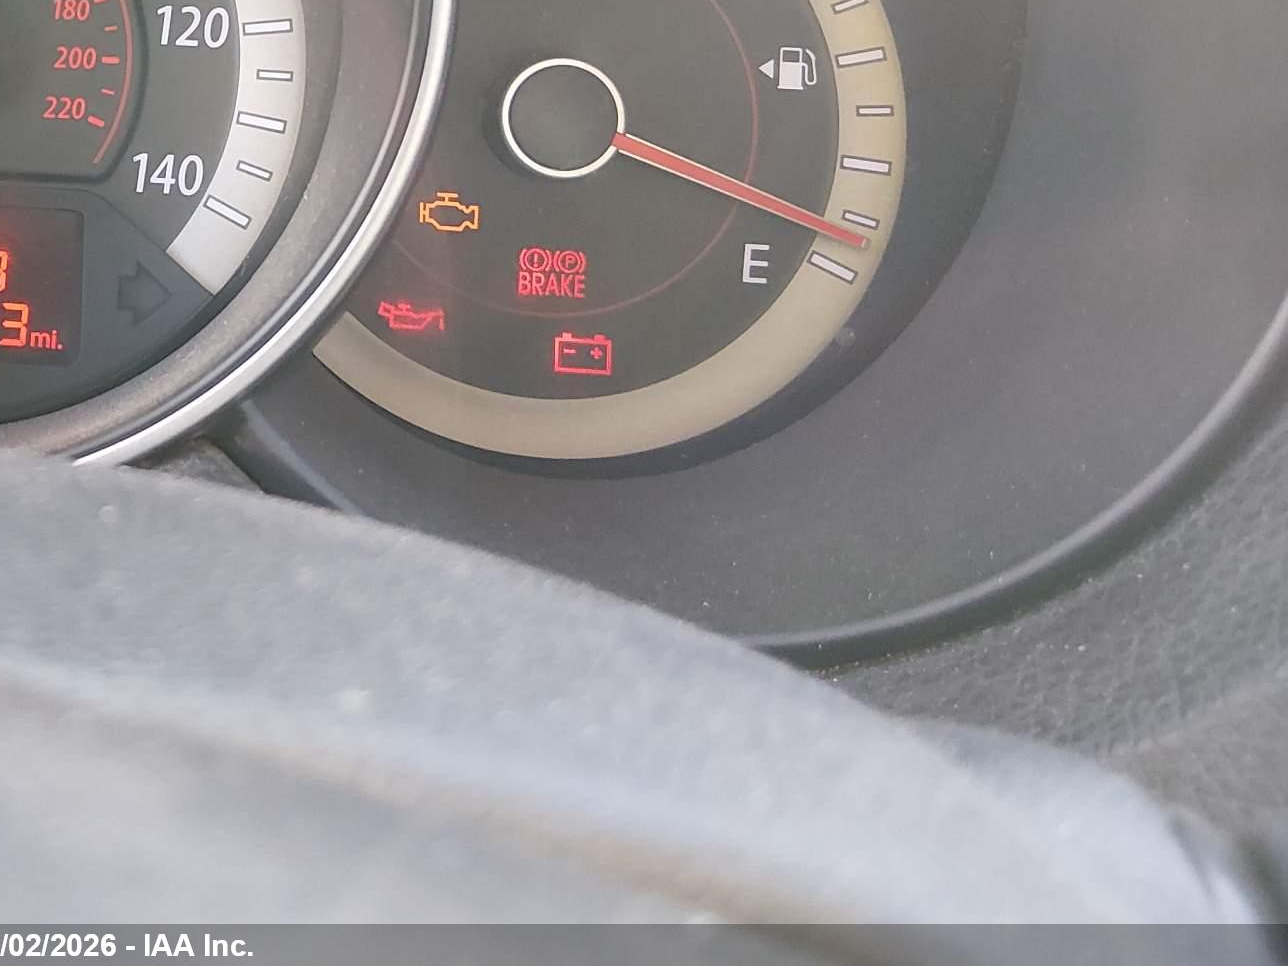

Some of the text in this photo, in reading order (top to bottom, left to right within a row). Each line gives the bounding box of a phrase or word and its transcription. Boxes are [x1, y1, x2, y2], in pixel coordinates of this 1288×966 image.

[157, 5, 230, 49] 120
[53, 47, 97, 69] 200
[43, 97, 85, 120] 220
[132, 153, 204, 196] 140
[742, 244, 770, 284] E
[518, 272, 586, 298] BRAKE
[30, 329, 63, 350] mi.
